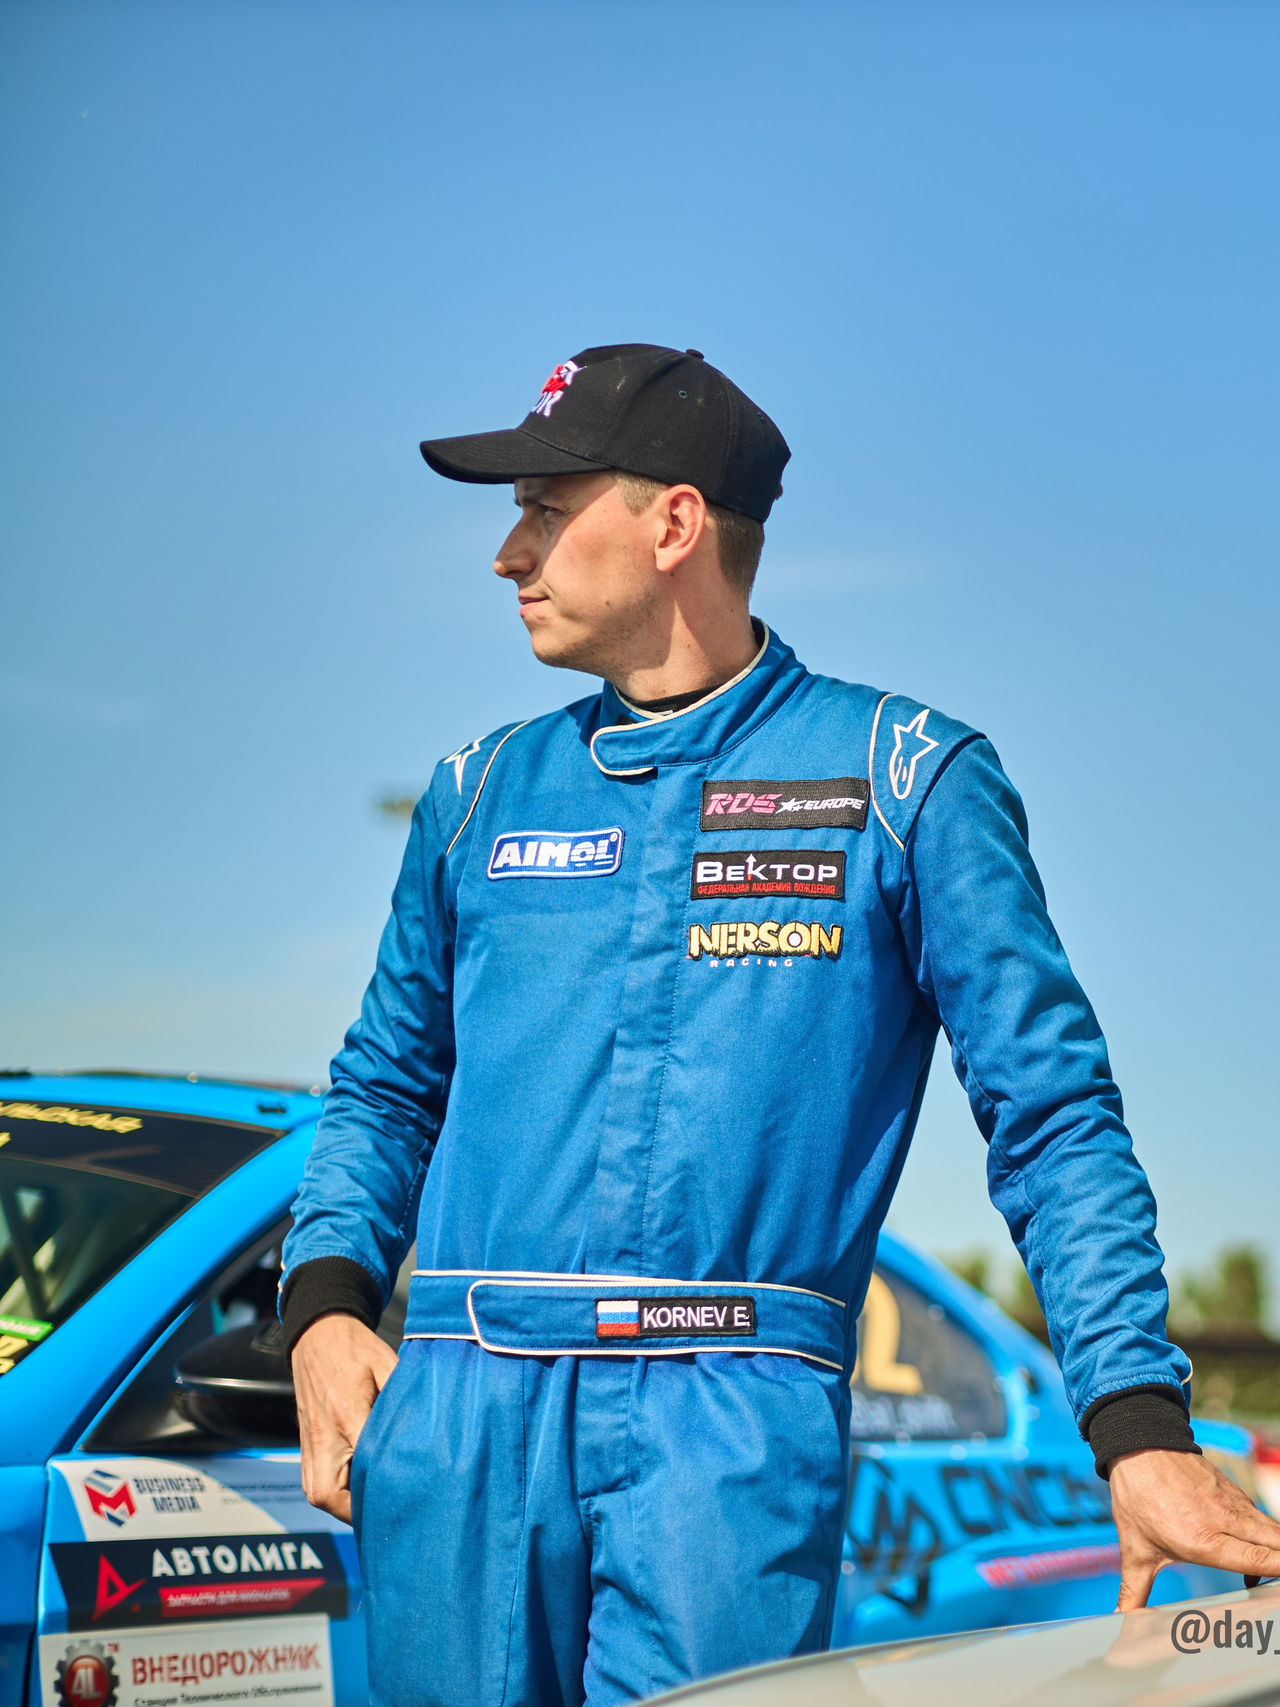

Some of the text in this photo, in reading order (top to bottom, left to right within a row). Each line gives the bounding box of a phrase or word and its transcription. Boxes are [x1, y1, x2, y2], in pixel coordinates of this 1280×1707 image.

[704, 793, 866, 815] RDS EUROPE
[688, 920, 843, 959] NERSON
[710, 957, 793, 968] RACING
[643, 1306, 728, 1328] KORNEV
[133, 1477, 206, 1494] BUSINESS
[152, 1495, 202, 1513] MEDIA
[152, 1541, 324, 1577] АВТОЛИГА
[131, 1643, 322, 1687] ВНЕДОРОЖНИК
